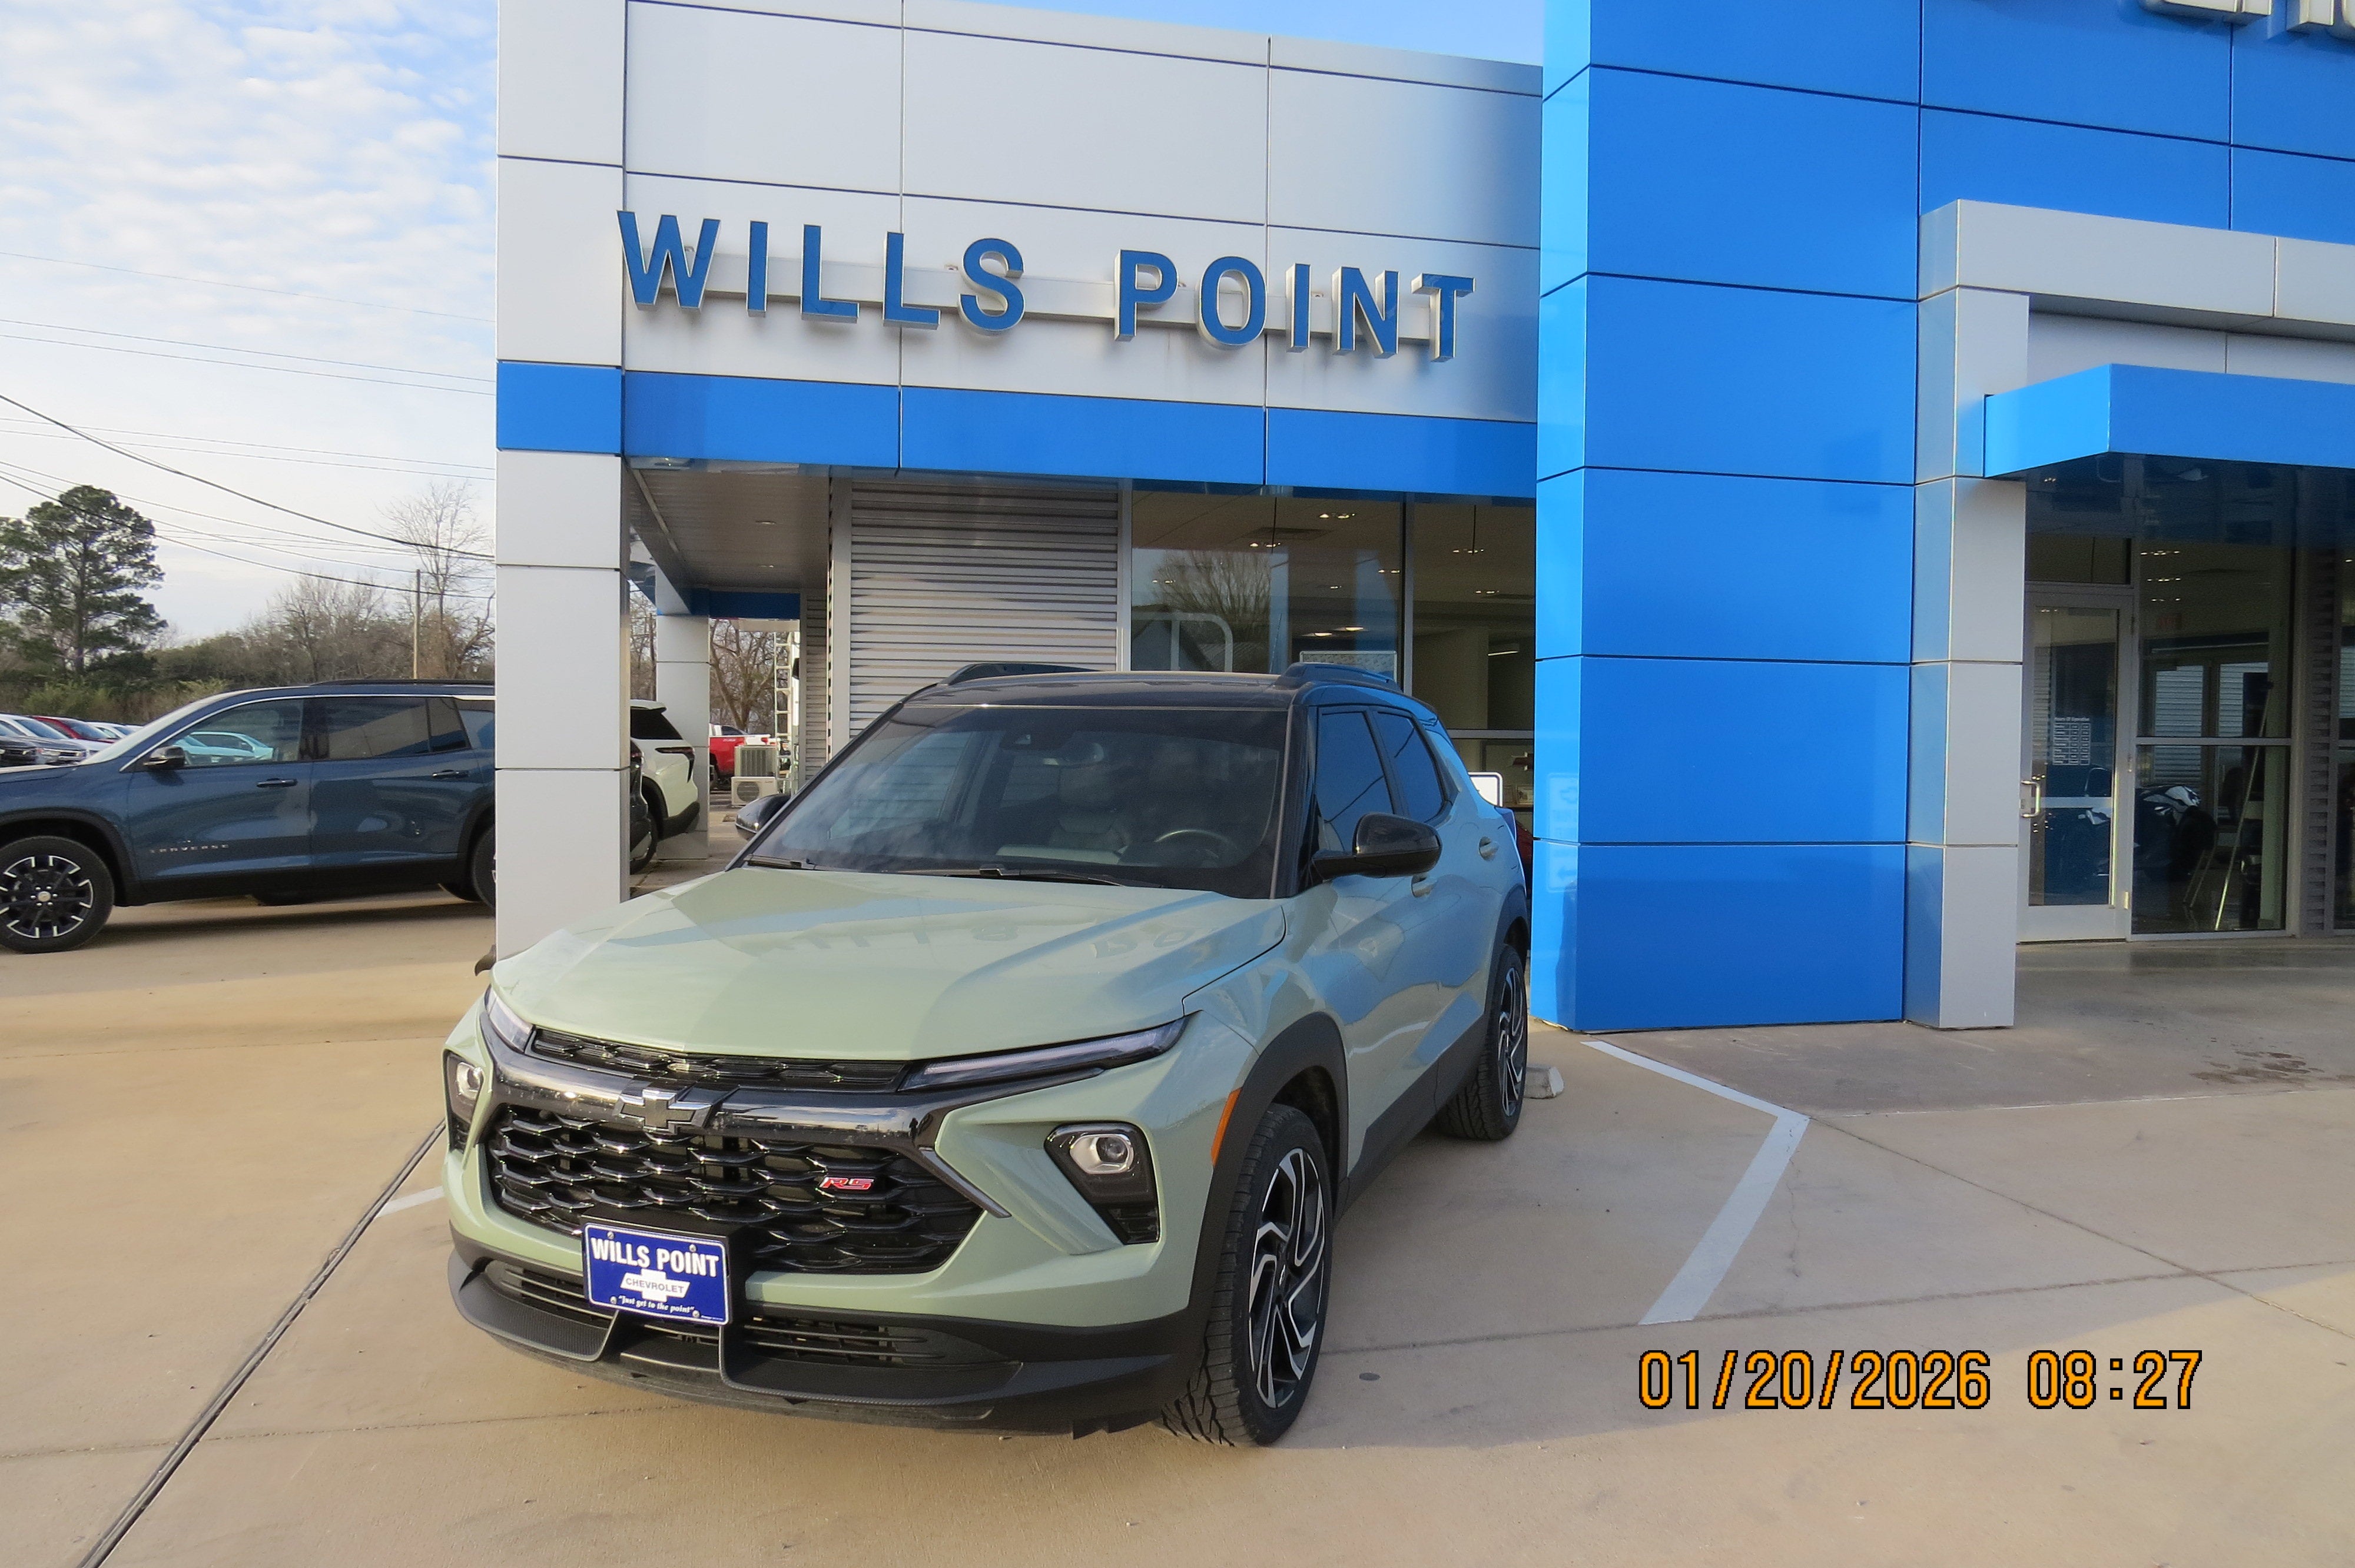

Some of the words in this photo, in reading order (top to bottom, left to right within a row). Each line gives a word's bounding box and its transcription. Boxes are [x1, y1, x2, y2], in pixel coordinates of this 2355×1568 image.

[616, 210, 1026, 335] WILLS
[1113, 249, 1475, 363] POINT
[819, 1176, 874, 1190] RS
[591, 1237, 651, 1268] WILLS
[656, 1248, 719, 1277] POINT
[625, 1278, 684, 1293] CHEVROLET
[636, 1300, 647, 1308] get
[656, 1302, 669, 1311] the
